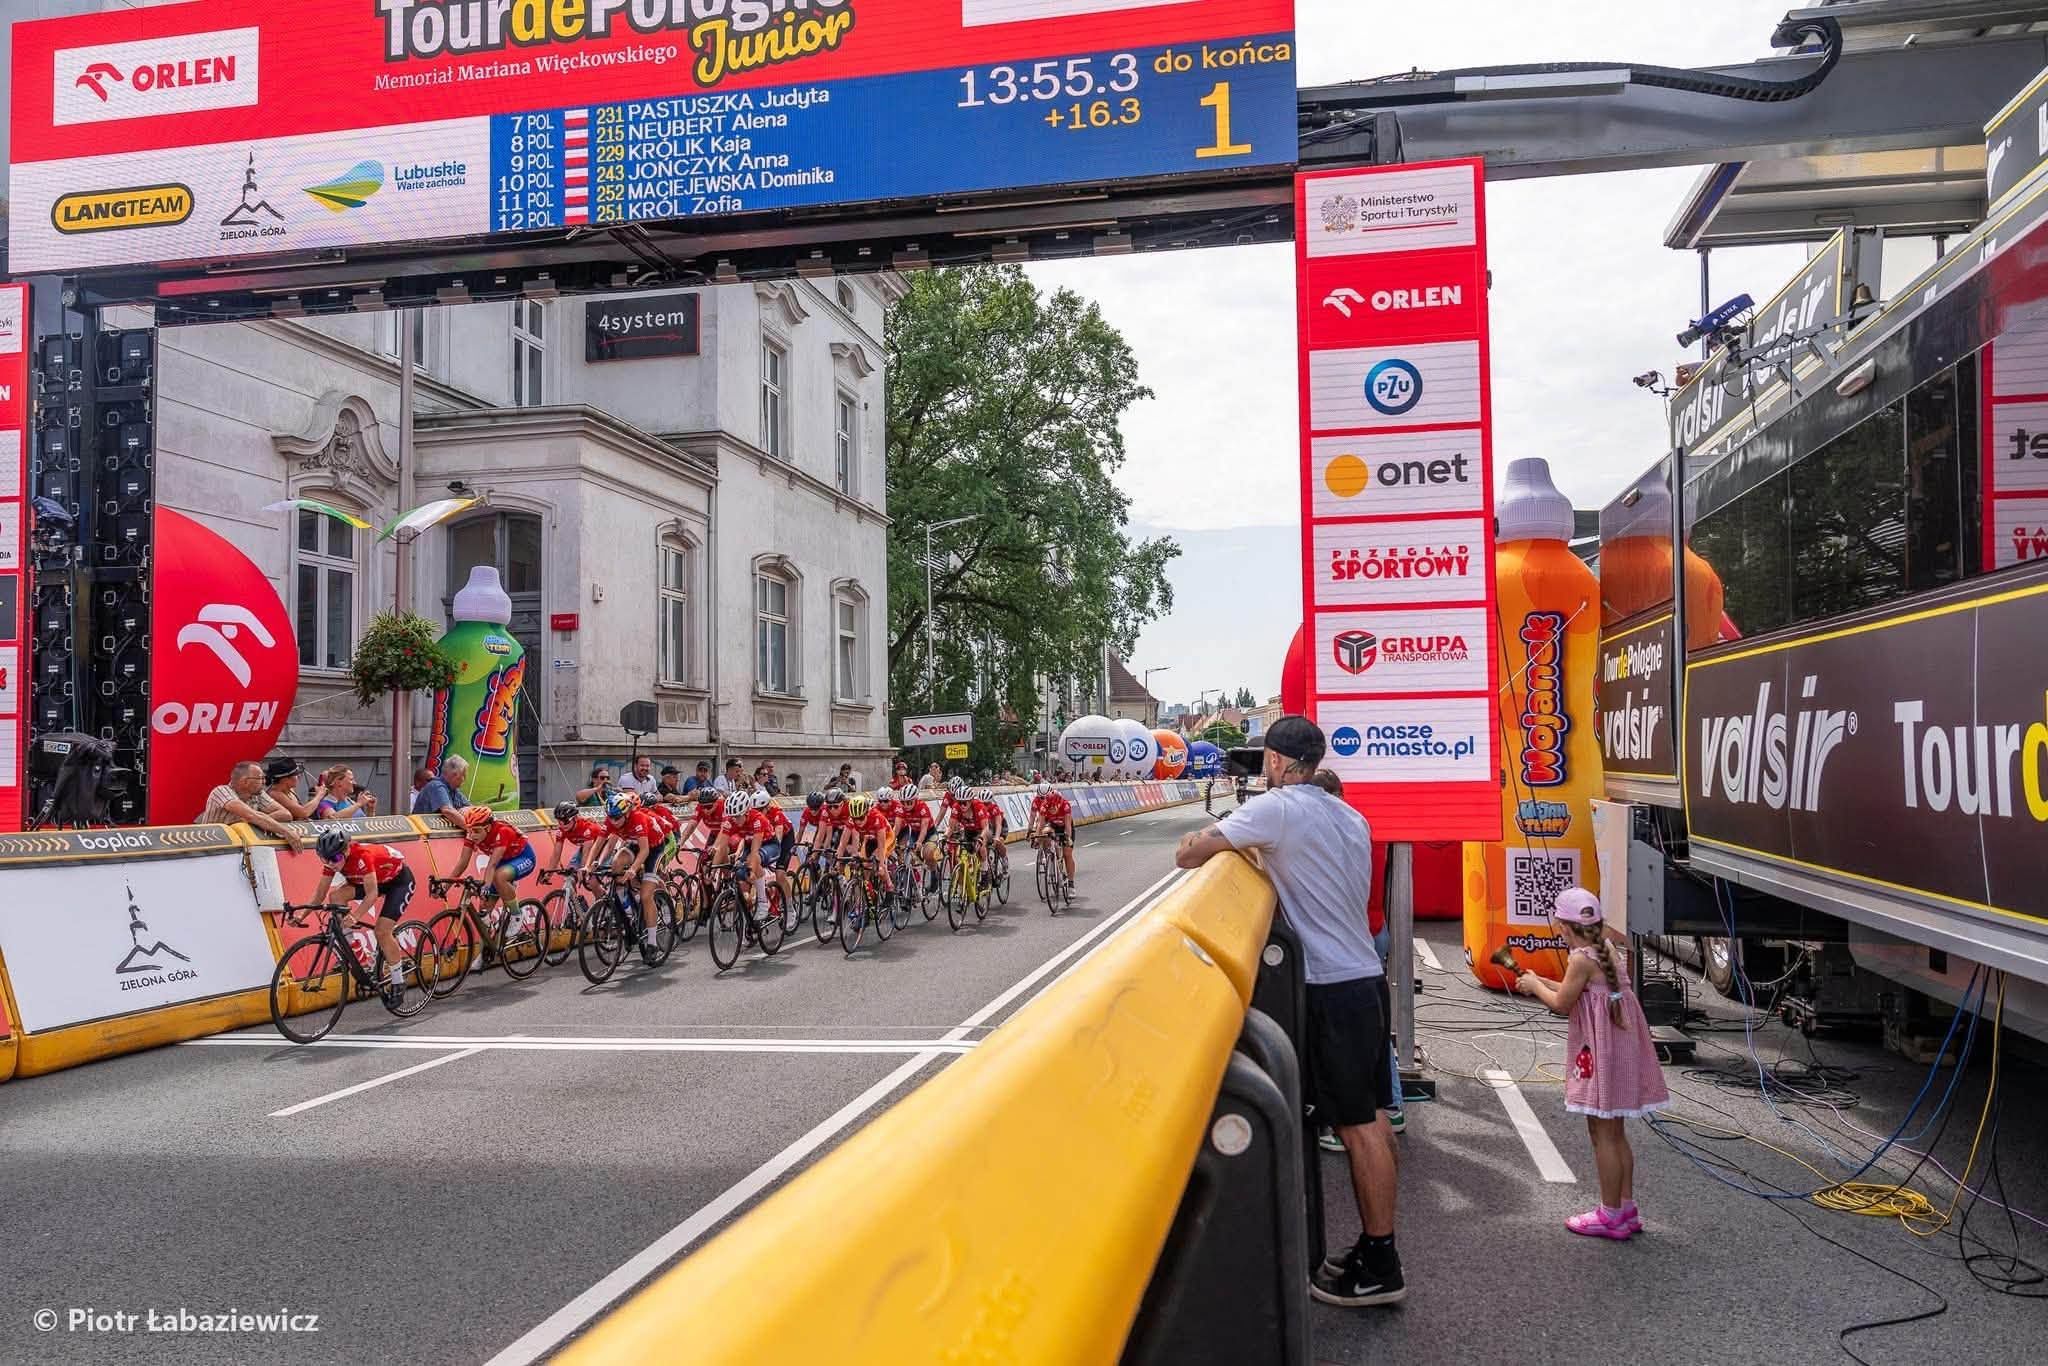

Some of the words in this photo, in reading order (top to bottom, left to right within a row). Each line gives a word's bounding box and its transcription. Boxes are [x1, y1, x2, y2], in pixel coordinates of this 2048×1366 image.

[693, 11, 850, 83] Junior
[1154, 49, 1192, 73] do
[1202, 40, 1291, 69] końca
[132, 55, 236, 92] ORLEN
[374, 67, 452, 90] Memoriał
[457, 61, 531, 81] Mariana
[535, 45, 677, 74] Więckowskiego
[957, 53, 1139, 108] 13:55.3
[511, 117, 523, 134] 7
[528, 115, 554, 131] POL
[597, 108, 624, 125] 231
[629, 95, 753, 122] PASTUSZKA
[760, 88, 830, 113] Judyta
[1045, 97, 1140, 129] +16.3
[1195, 81, 1251, 158] 1
[511, 137, 523, 152] 8
[528, 134, 554, 149] POL
[596, 128, 624, 143] 215
[629, 116, 726, 140] NEUBERT
[732, 112, 788, 131] Alena
[511, 155, 523, 172] 9
[528, 152, 554, 169] POL
[596, 146, 624, 162] 229
[629, 137, 704, 161] KRÓLIK
[711, 137, 751, 155] Kaja
[395, 161, 466, 180] Lubuskie
[397, 181, 424, 191] Warte
[426, 177, 465, 188] zachodu
[499, 175, 524, 192] 10
[528, 172, 554, 188] POL
[596, 166, 624, 182] 243
[629, 154, 732, 181] JOŃCZYK
[738, 152, 789, 170] Anna
[499, 195, 523, 212] 11
[528, 191, 554, 207] POL
[596, 185, 624, 201] 252
[629, 174, 756, 200] MACIEJEWSKA
[761, 167, 834, 189] Dominika
[1361, 192, 1434, 207] Ministerstwo
[63, 195, 183, 222] LANGTEAM
[499, 214, 524, 231] 12
[528, 210, 554, 227] POL
[596, 204, 624, 221] 251
[629, 197, 688, 219] KRÓL
[692, 195, 742, 215] Zofia
[1361, 209, 1398, 222] Sportu
[1406, 203, 1458, 218] Turystyki
[220, 229, 258, 240] ZIELONA
[260, 225, 287, 236] GÓRA
[1371, 285, 1462, 311] ORLEN
[599, 311, 684, 334] 4system
[1377, 375, 1410, 399] PZU
[1377, 453, 1468, 486] onet
[1331, 556, 1469, 580] SPORTOWY
[1381, 636, 1468, 653] GRUPA
[1382, 652, 1469, 663] TRANSPORTOWA
[1521, 615, 1568, 784] Wojanek
[152, 701, 279, 734] ORLEN
[929, 724, 967, 736] ORLEN
[1367, 725, 1432, 739] nasze
[1367, 736, 1474, 759] miasto.pl
[119, 974, 166, 992] ZIELONA
[167, 968, 199, 984] GÓRA
